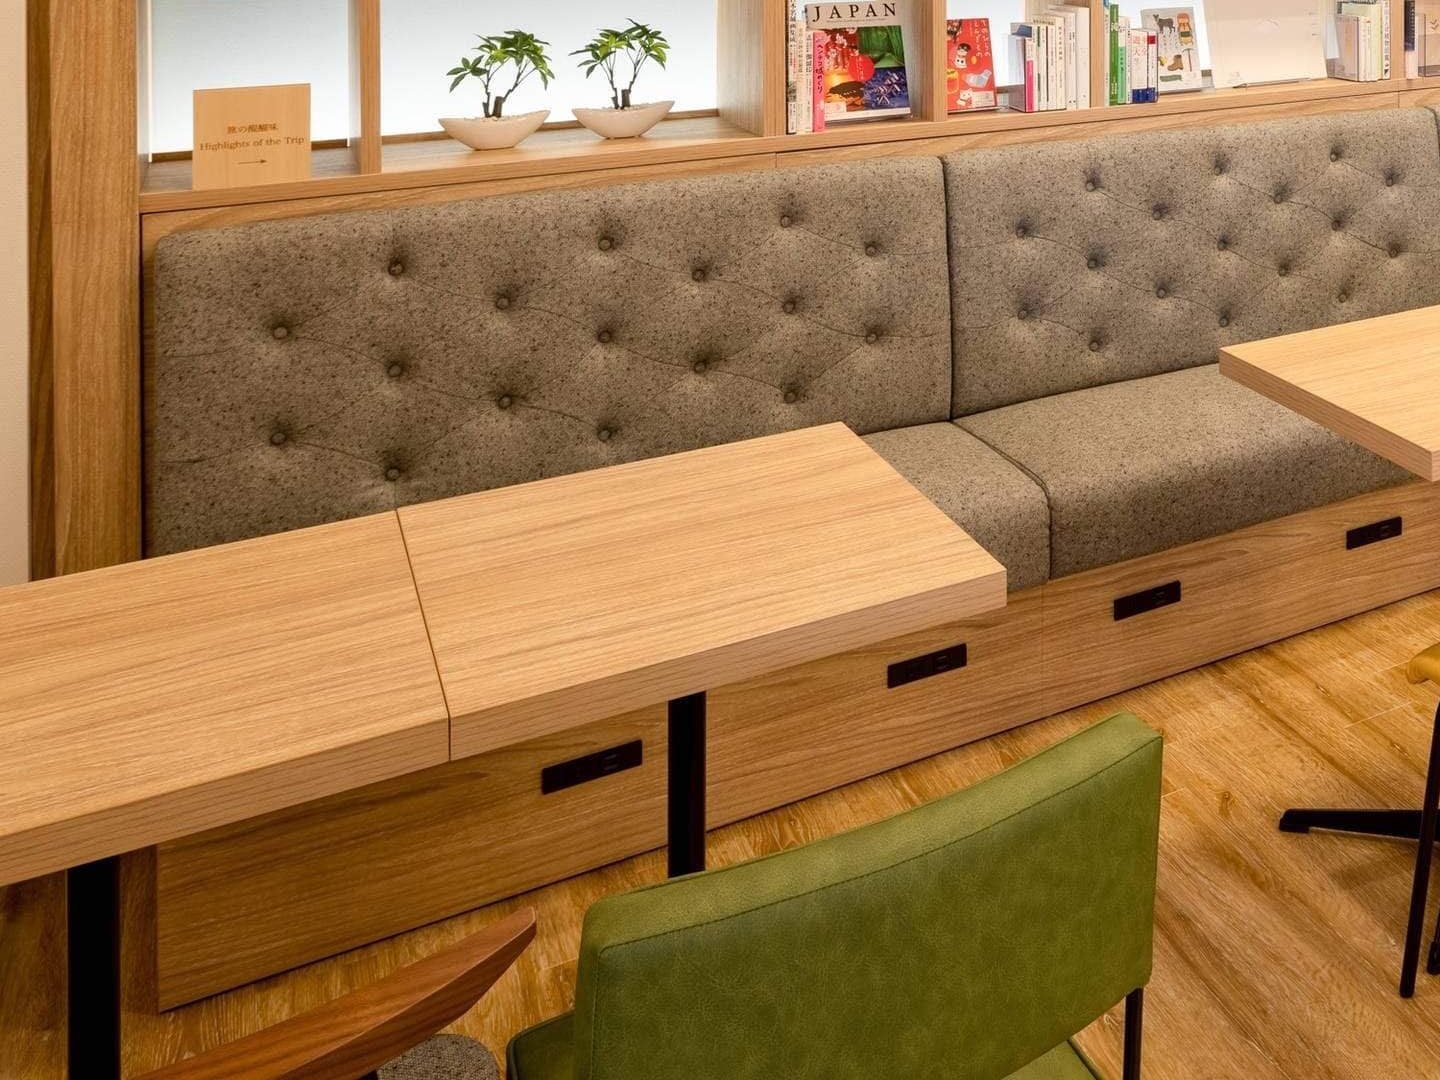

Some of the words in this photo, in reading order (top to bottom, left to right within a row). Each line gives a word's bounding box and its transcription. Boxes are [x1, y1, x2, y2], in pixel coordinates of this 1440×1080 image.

[812, 3, 897, 23] JAPAN
[200, 140, 250, 151] Highlights
[253, 139, 264, 147] of
[266, 137, 282, 146] the
[285, 136, 304, 145] Trip
